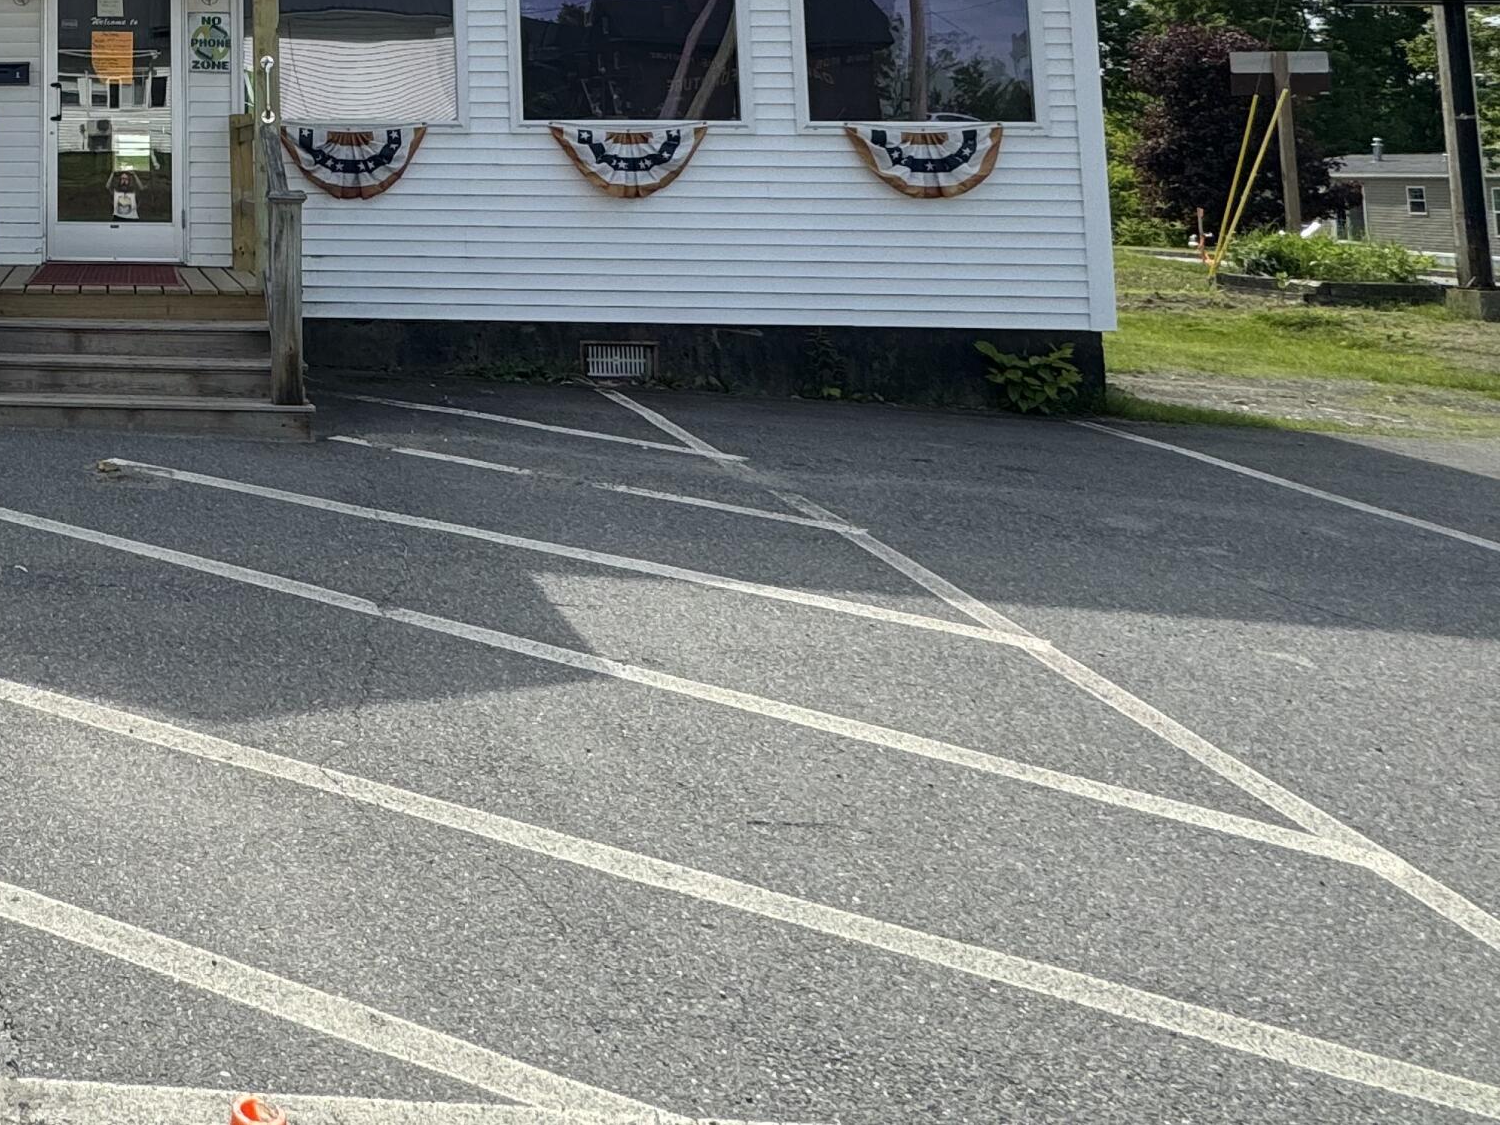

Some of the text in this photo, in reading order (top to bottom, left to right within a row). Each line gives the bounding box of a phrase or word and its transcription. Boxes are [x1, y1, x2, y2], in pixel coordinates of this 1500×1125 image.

[201, 16, 222, 25] NO
[190, 38, 232, 48] PHONE
[192, 60, 230, 70] ZONE
